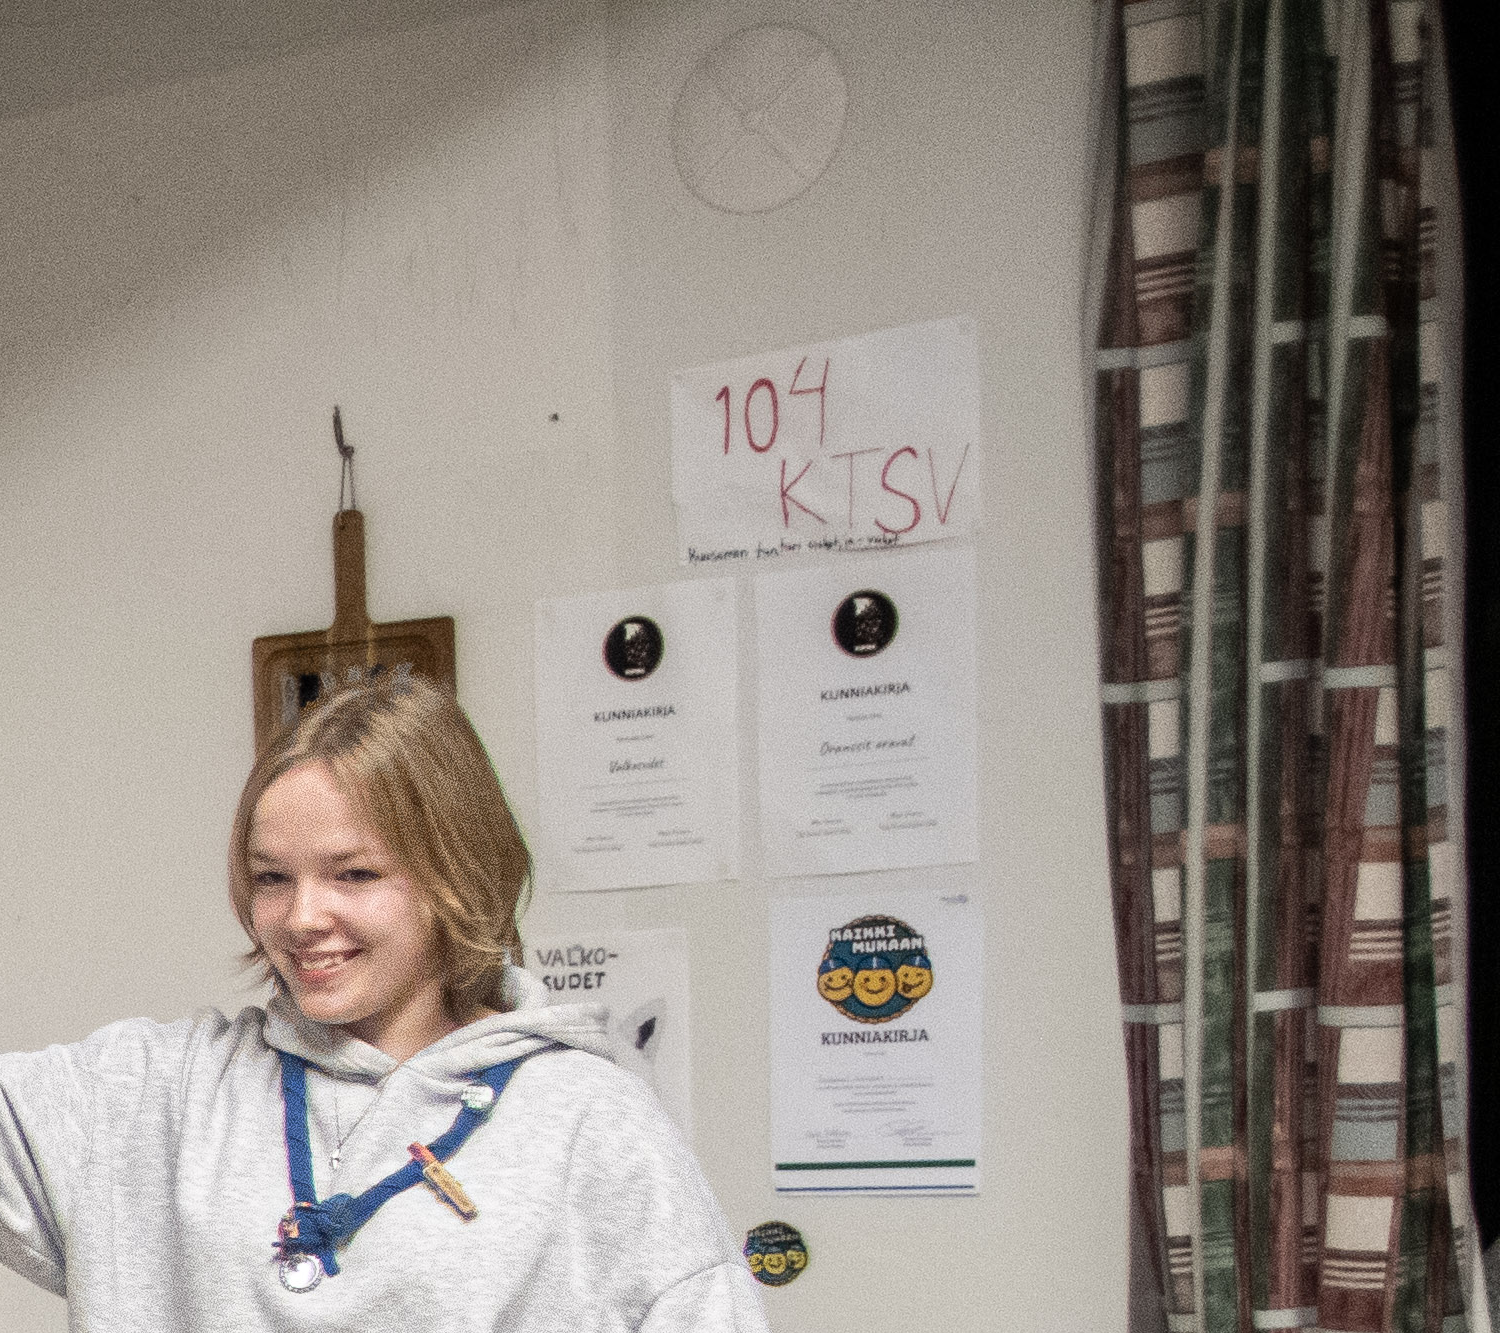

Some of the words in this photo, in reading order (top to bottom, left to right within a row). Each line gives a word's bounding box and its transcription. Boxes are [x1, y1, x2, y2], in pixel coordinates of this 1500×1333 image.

[715, 356, 829, 455] 104
[780, 443, 970, 535] KTSV
[820, 681, 912, 701] KUNNIAKIRJA
[593, 705, 677, 723] KUNNIAKIRJA
[541, 972, 606, 992] SUDET
[820, 1028, 929, 1046] KUNNIAKIRJA
